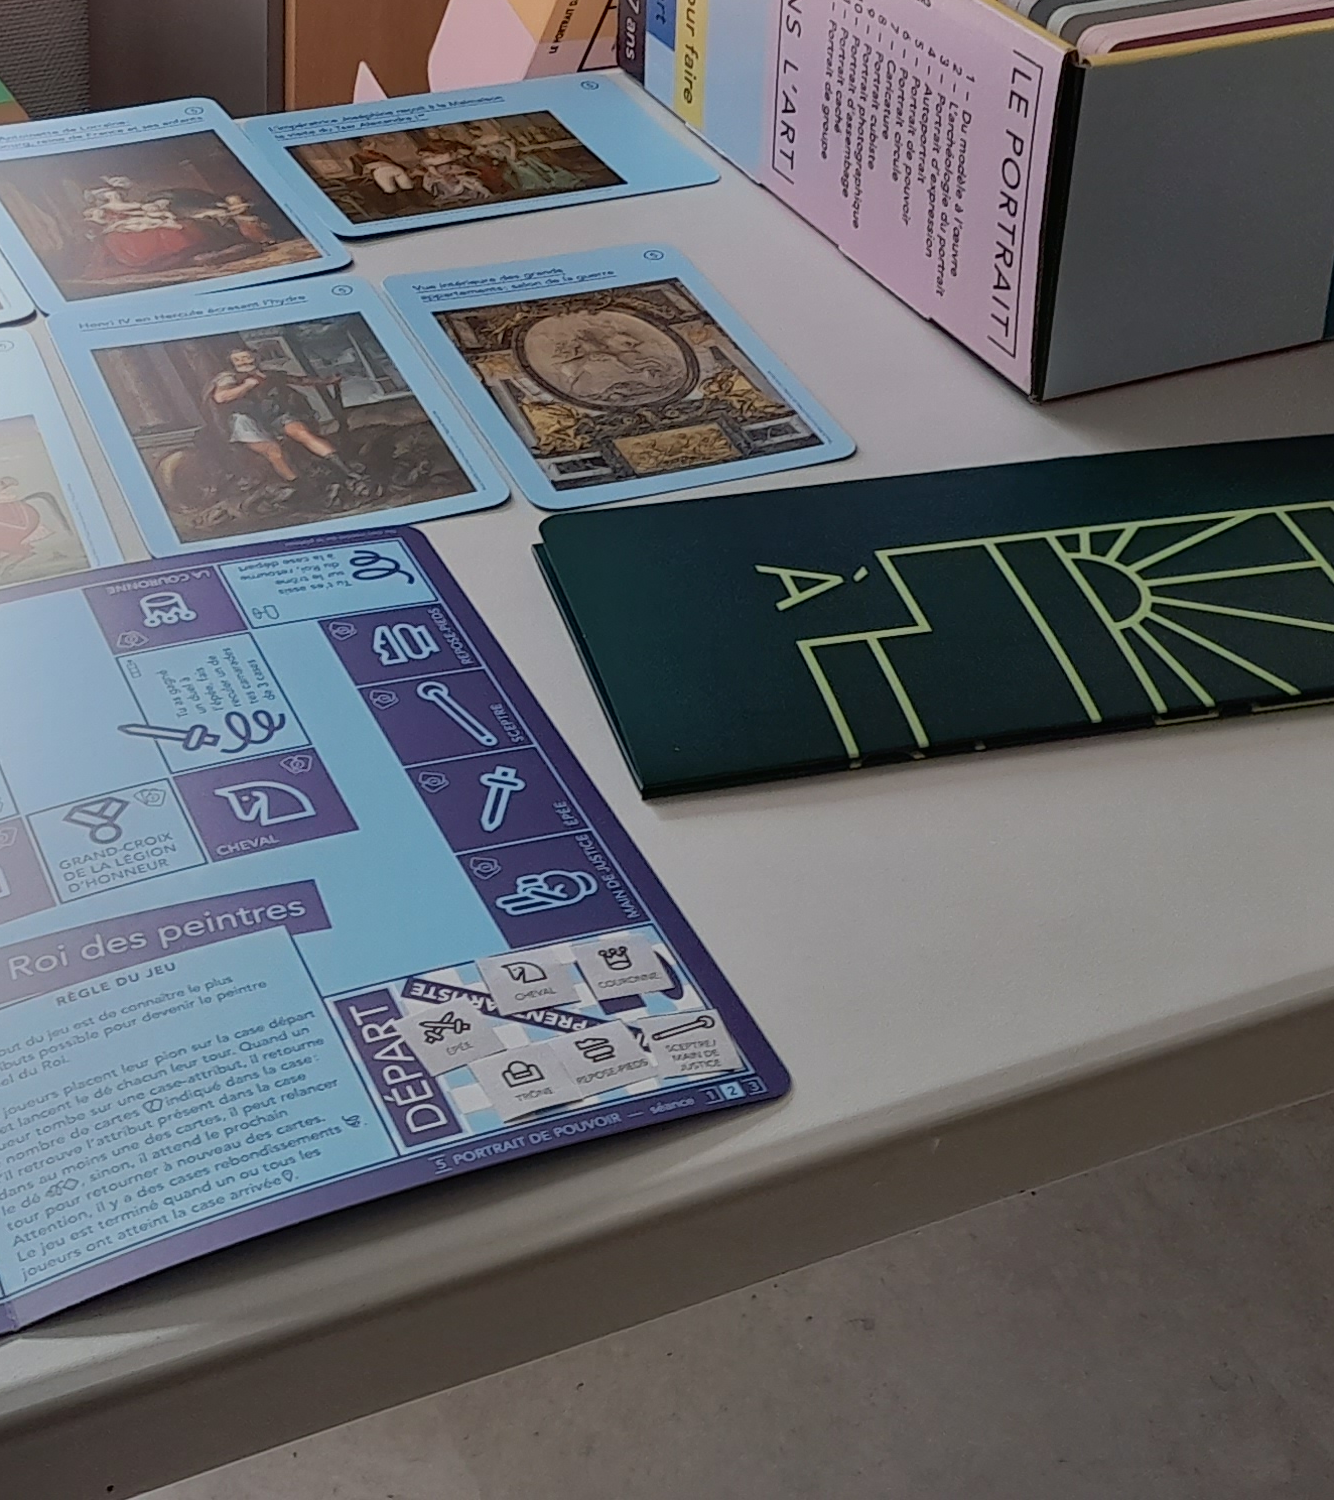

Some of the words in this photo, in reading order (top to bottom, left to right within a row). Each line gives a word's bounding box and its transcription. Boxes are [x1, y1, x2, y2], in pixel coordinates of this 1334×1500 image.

[624, 16, 638, 61] ans
[825, 19, 837, 79] Portrait
[836, 27, 849, 87] Portrait
[847, 34, 861, 95] Portrait
[940, 55, 950, 67] 3
[682, 46, 700, 105] faire
[859, 43, 872, 102] Portrait
[870, 51, 884, 111] Portrait
[896, 67, 909, 128] Portrait
[953, 63, 963, 76] 2
[1005, 70, 1033, 119] LE
[777, 69, 800, 172] L'ART
[882, 59, 896, 140] Caricature
[908, 75, 921, 137] Portrait
[931, 92, 946, 154] Portrait
[961, 109, 972, 133] Du
[820, 103, 831, 160] groupe
[867, 113, 878, 171] cubiste
[917, 83, 933, 185] Autoportrait
[941, 100, 959, 208] L'archéologie
[852, 102, 867, 229] photographique
[900, 162, 913, 227] pouvoir
[956, 137, 968, 200] modèle
[925, 156, 941, 259] d'expression
[940, 211, 951, 234] du
[989, 129, 1025, 339] PORTRAIT
[935, 234, 947, 298] portrait
[78, 320, 115, 330] Henri
[105, 574, 190, 596] COURONNE
[193, 569, 212, 579] LA
[755, 563, 870, 614] À
[427, 607, 474, 665] REPOSE-PIEDS
[490, 703, 525, 744] SCEPTRE
[58, 832, 174, 871] GRAND-CROIX
[63, 869, 87, 882] DE
[91, 862, 115, 874] LA
[117, 843, 177, 866] LÉGION
[217, 835, 280, 855] CHEVAL
[574, 834, 609, 872] JUSTICE
[68, 858, 170, 893] D'HONNEUR
[601, 871, 617, 891] DE
[616, 891, 641, 920] MAIN
[7, 945, 69, 981] Roi
[80, 930, 148, 960] des
[157, 898, 307, 950] peintres
[25, 1031, 44, 1047] du
[46, 1025, 70, 1045] jeu
[72, 1016, 95, 1031] est
[98, 1007, 118, 1023] de
[121, 987, 185, 1016] connaître
[187, 981, 201, 994] le
[203, 974, 235, 992] plus
[55, 979, 112, 1007] RÈGLE
[116, 972, 141, 987] DU
[146, 961, 177, 978] JEU
[514, 987, 558, 1001] CHEVAL
[38, 1029, 98, 1059] possible
[103, 1019, 139, 1039] pour
[141, 999, 195, 1023] devenir
[197, 995, 212, 1006] le
[216, 979, 267, 1002] peintre
[349, 1004, 448, 1134] DÉPART
[575, 1058, 649, 1085] REPOSE-PIEDS
[452, 1137, 525, 1166] PORTRAIT
[529, 1129, 553, 1145] DE
[553, 1112, 622, 1137] POUVOIR
[650, 1096, 695, 1115] séance
[728, 1085, 738, 1096] 2
[750, 1081, 760, 1092] 3
